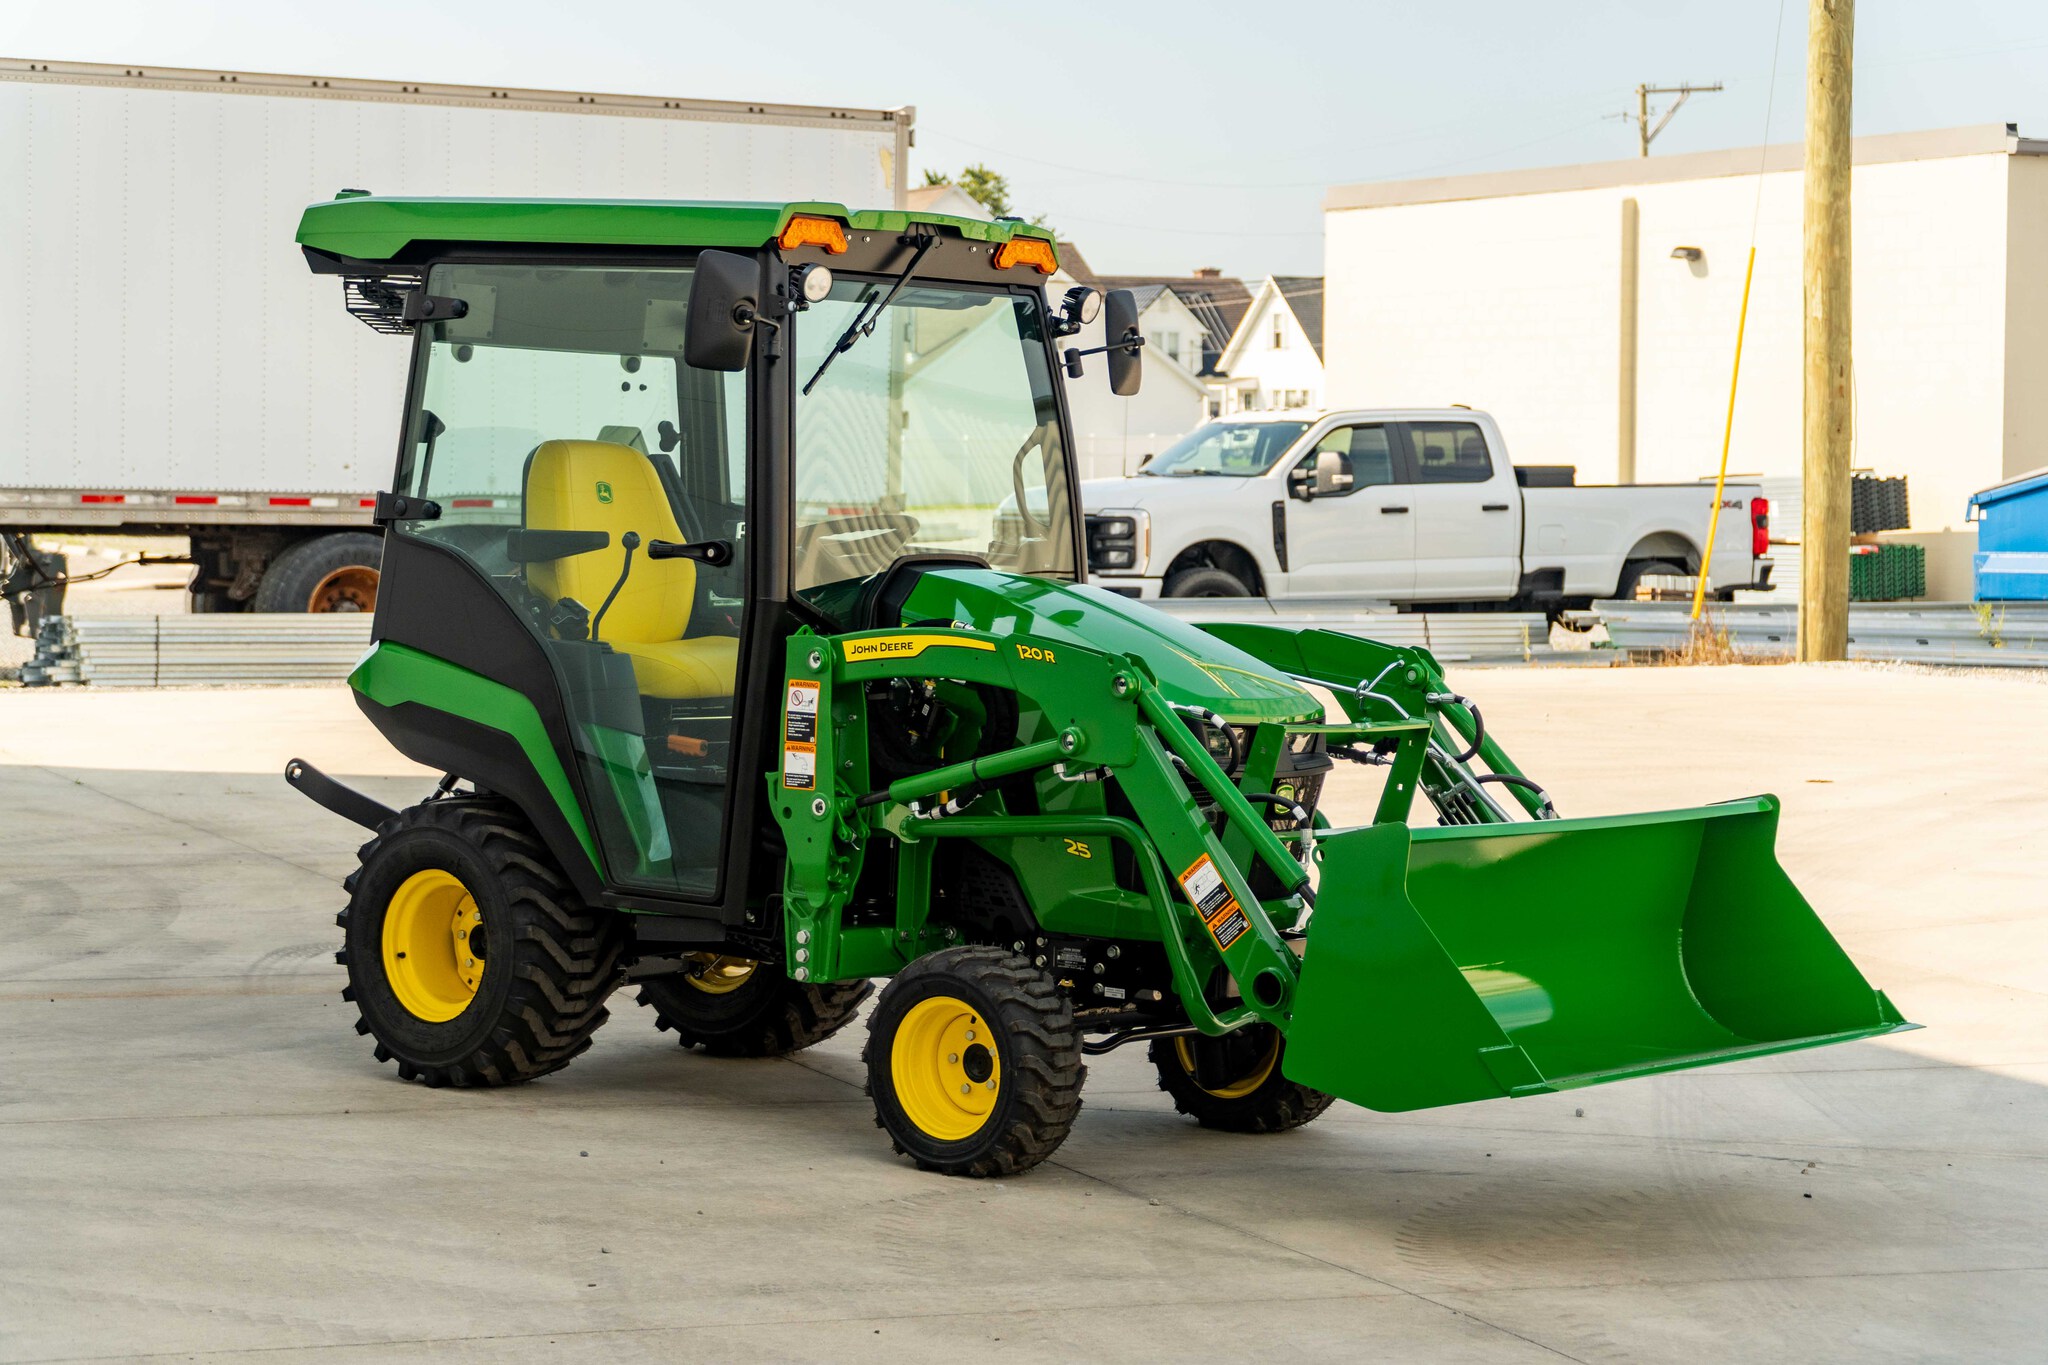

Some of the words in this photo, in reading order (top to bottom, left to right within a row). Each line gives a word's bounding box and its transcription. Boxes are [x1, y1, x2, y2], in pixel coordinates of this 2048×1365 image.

[851, 643, 878, 655] JOHN
[880, 641, 914, 652] DEERE
[1015, 643, 1043, 661] 120
[1046, 649, 1056, 664] R
[795, 681, 818, 689] WARNING
[791, 745, 814, 753] WARNING
[1063, 838, 1092, 859] 25
[1187, 857, 1206, 876] WARNING
[1217, 905, 1237, 924] WARNING
